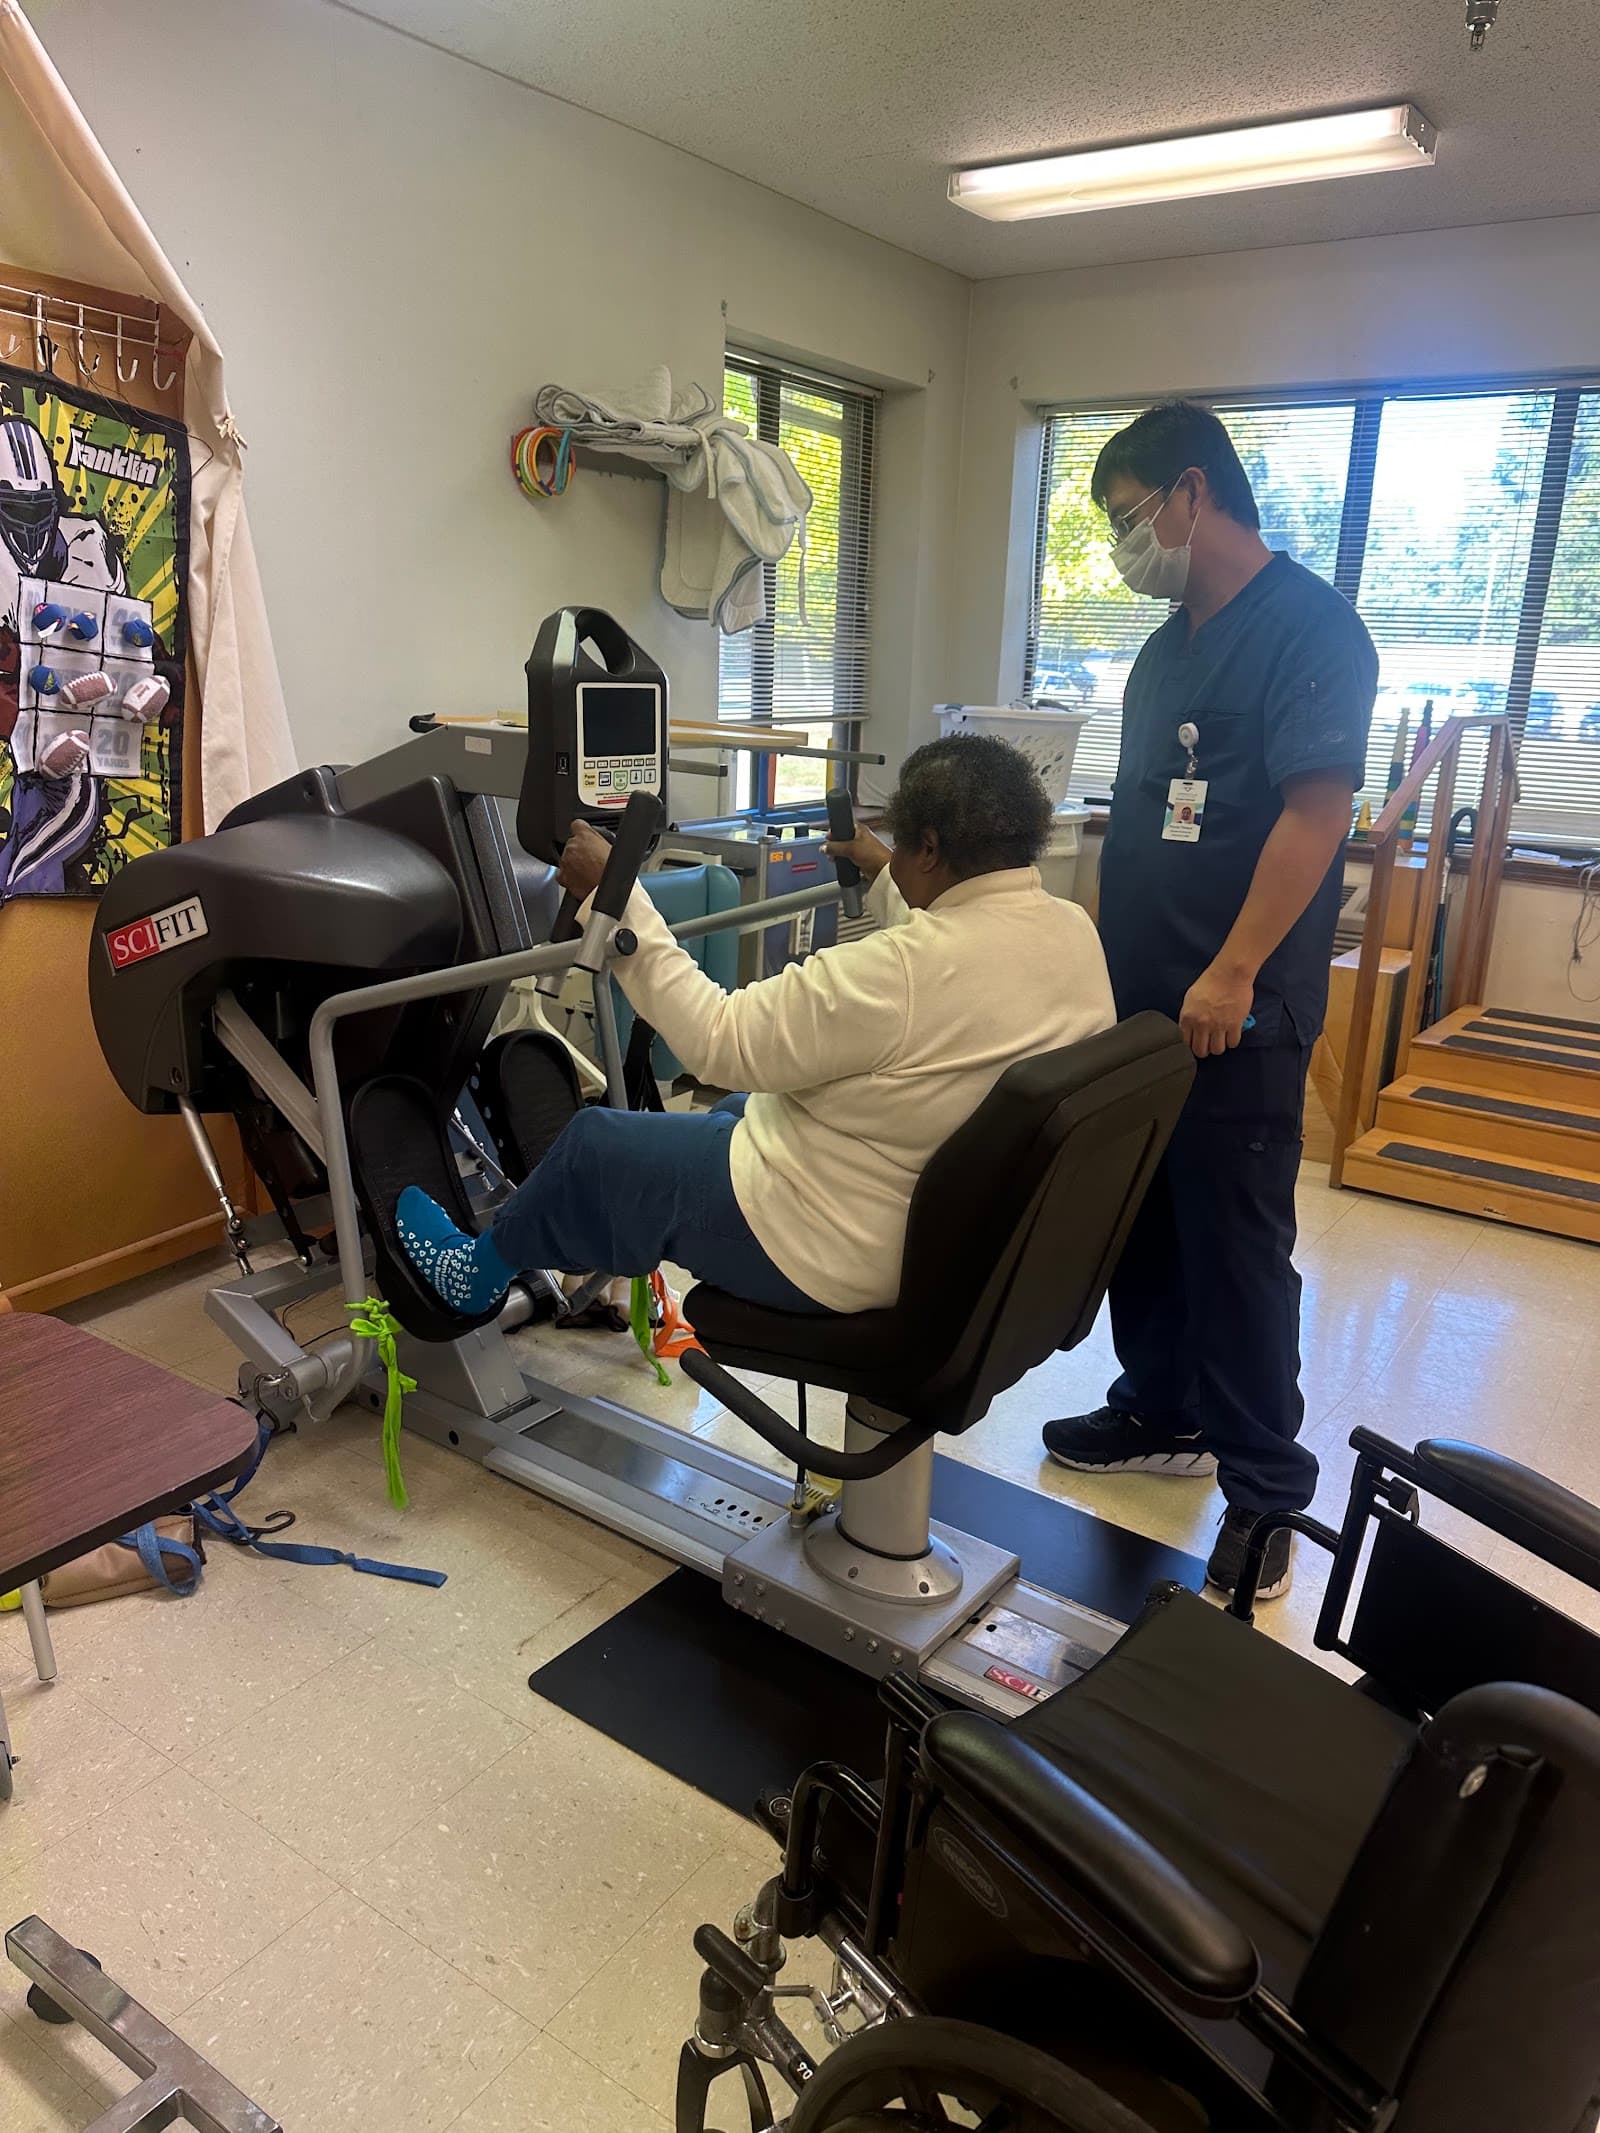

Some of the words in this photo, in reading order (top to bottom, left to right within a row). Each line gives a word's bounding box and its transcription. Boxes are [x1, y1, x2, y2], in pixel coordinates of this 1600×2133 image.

[68, 427, 157, 485] Franklin
[97, 729, 130, 755] 20
[96, 757, 130, 769] YARDS
[113, 905, 198, 961] SCIFIT
[989, 1667, 1051, 1699] SCIF
